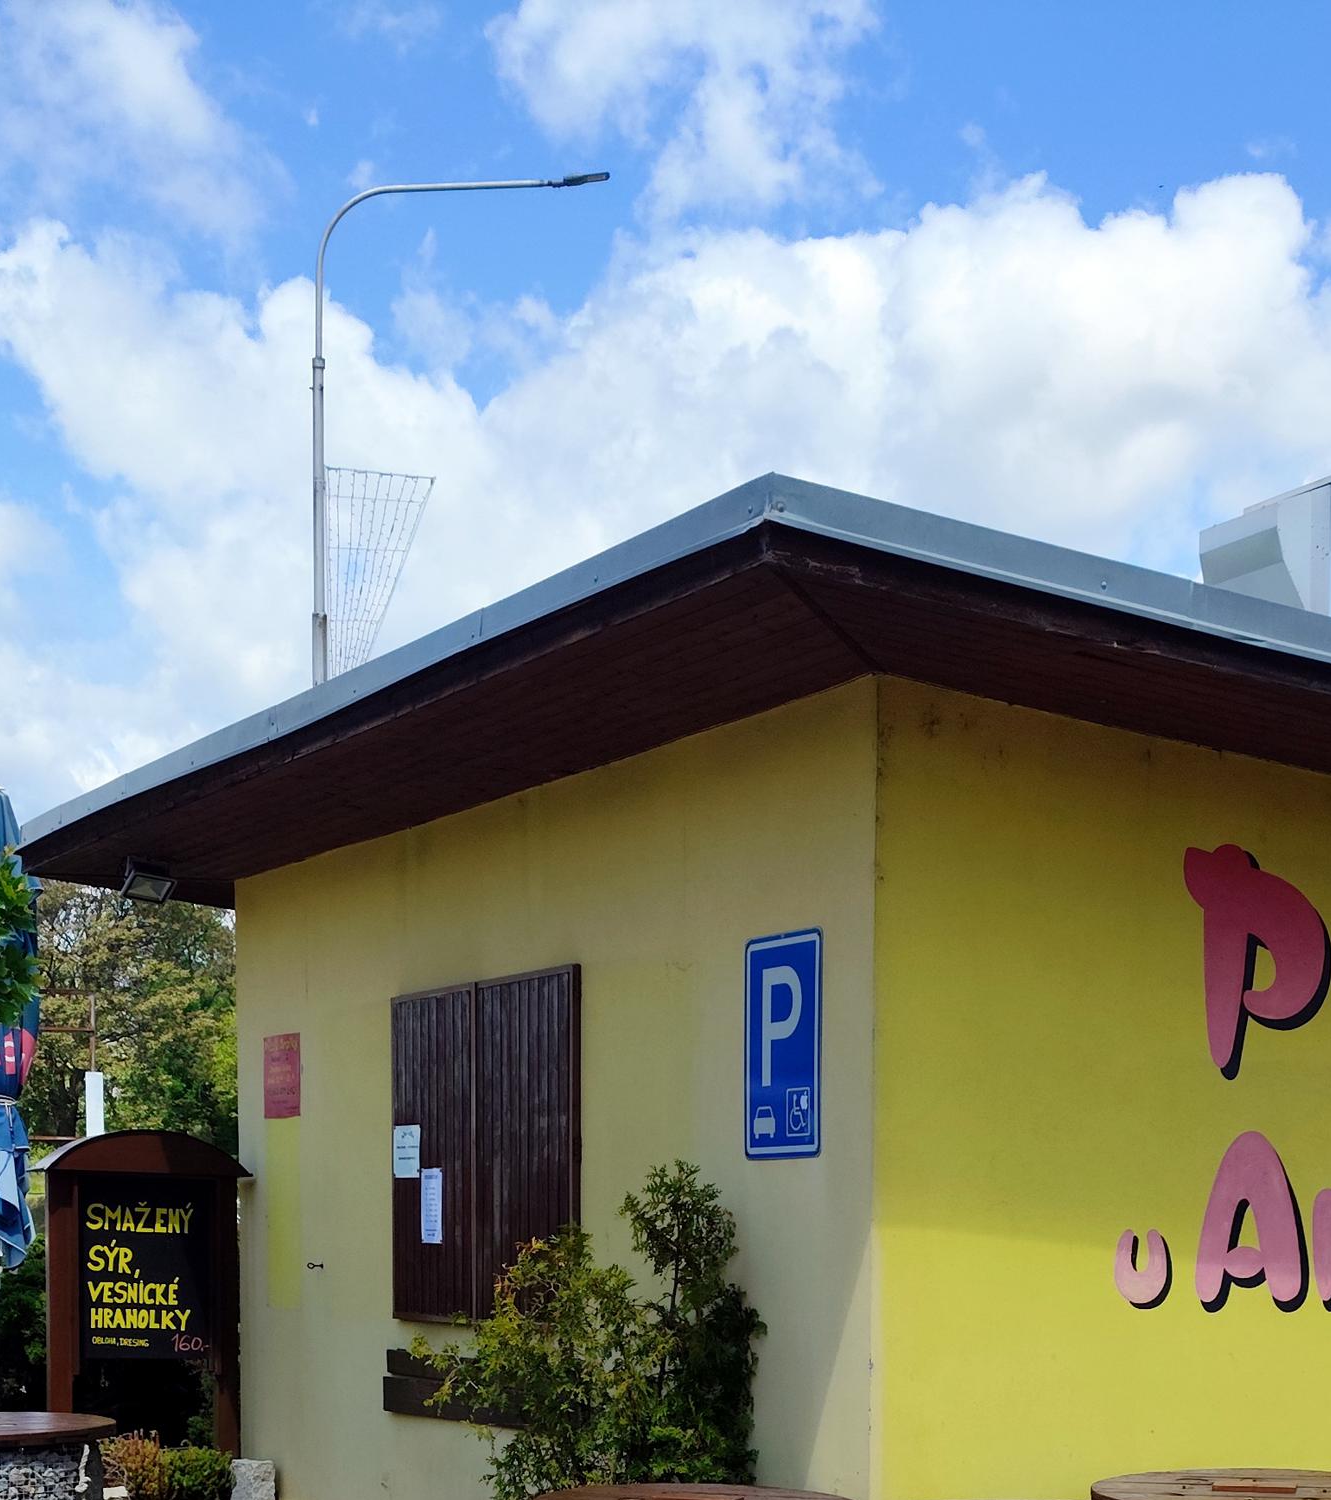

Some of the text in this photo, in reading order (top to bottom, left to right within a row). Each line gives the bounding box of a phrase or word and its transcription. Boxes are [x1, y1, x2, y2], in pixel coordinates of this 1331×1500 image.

[762, 965, 802, 1087] P
[86, 1201, 194, 1234] SMAŽENÝ
[87, 1239, 140, 1279] SÝR,
[1115, 1229, 1172, 1310] u
[88, 1277, 180, 1306] VESNICKÉ
[90, 1308, 191, 1332] HRANOLKY
